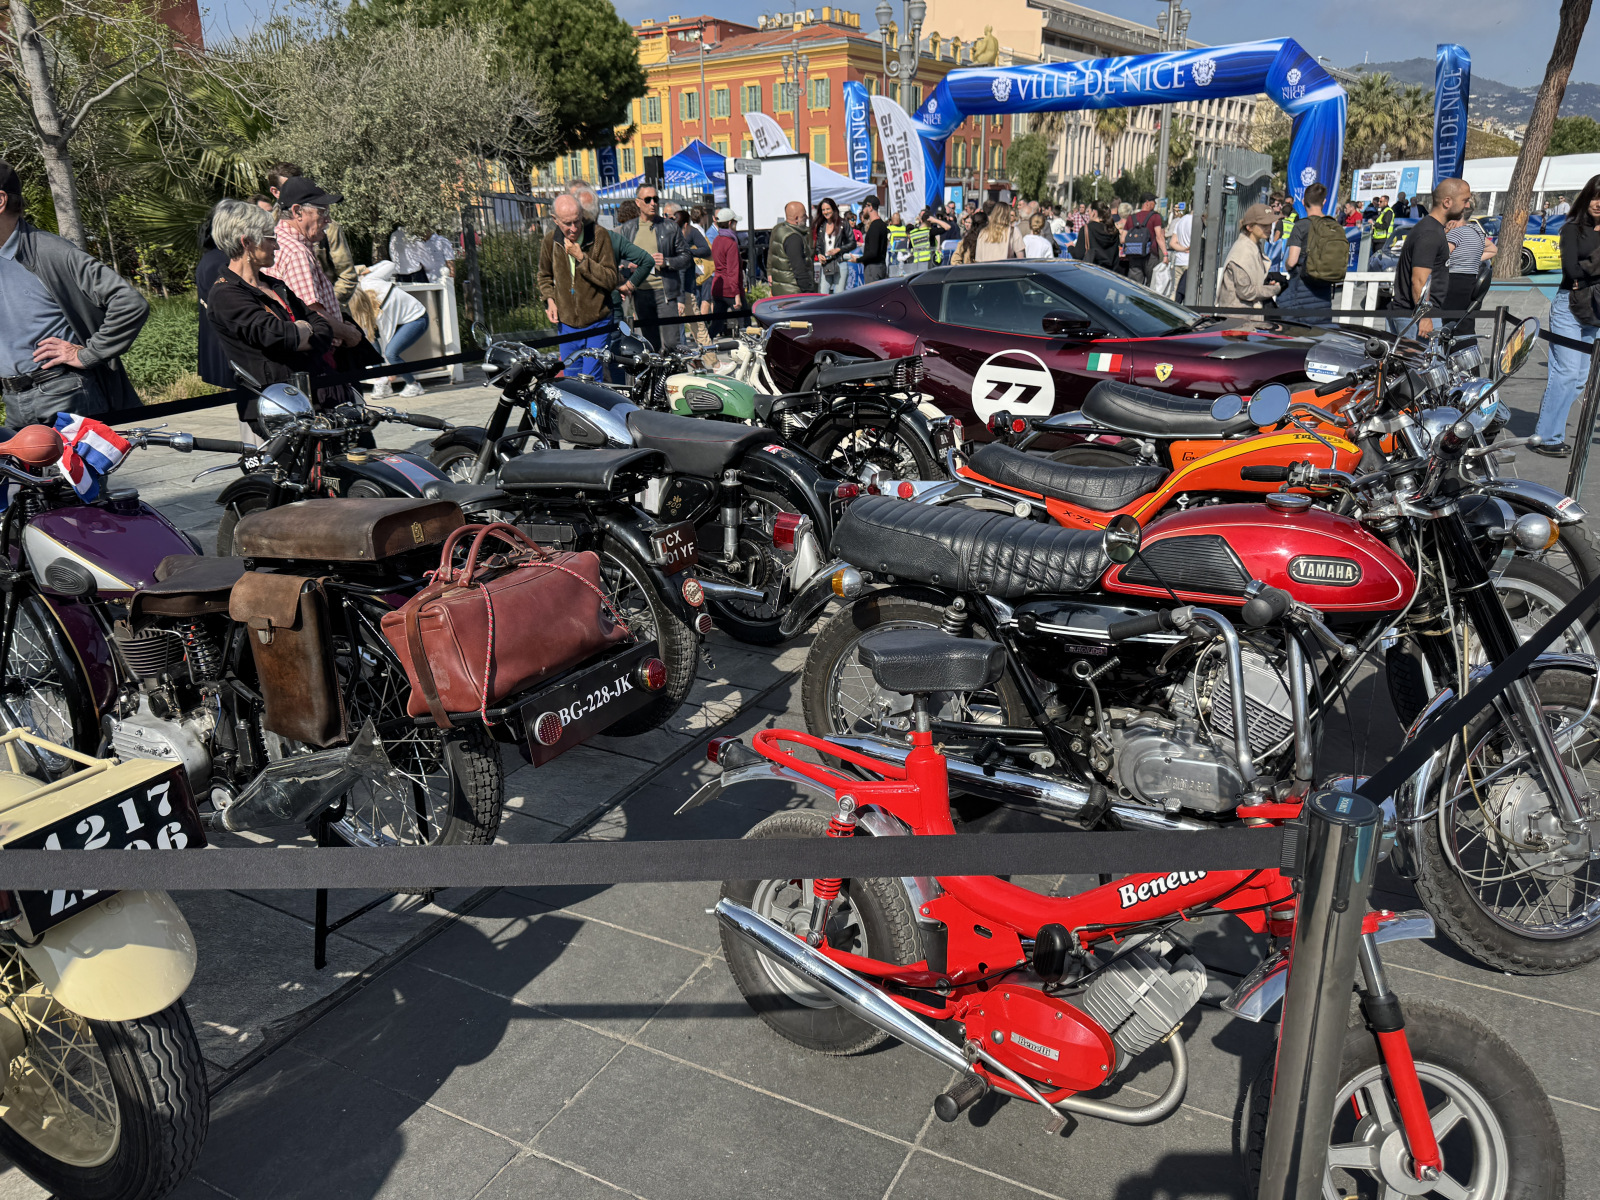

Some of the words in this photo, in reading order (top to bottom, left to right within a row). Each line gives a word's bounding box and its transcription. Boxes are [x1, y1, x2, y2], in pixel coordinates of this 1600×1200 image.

[1016, 70, 1077, 101] VILLE
[1083, 67, 1116, 97] DE
[1123, 61, 1186, 93] NICE
[1441, 67, 1462, 110] NICE
[1282, 90, 1305, 100] NICE
[850, 101, 867, 139] NICE
[1440, 114, 1459, 138] DE
[853, 141, 868, 162] DE
[984, 379, 1042, 404] 77
[1062, 510, 1091, 523] X-75
[666, 530, 682, 546] CX
[668, 549, 679, 564] 01
[680, 542, 694, 558] YF
[1299, 562, 1353, 580] YAMAHA
[558, 672, 634, 728] BG-228-JK
[1018, 1035, 1051, 1057] Benelli
